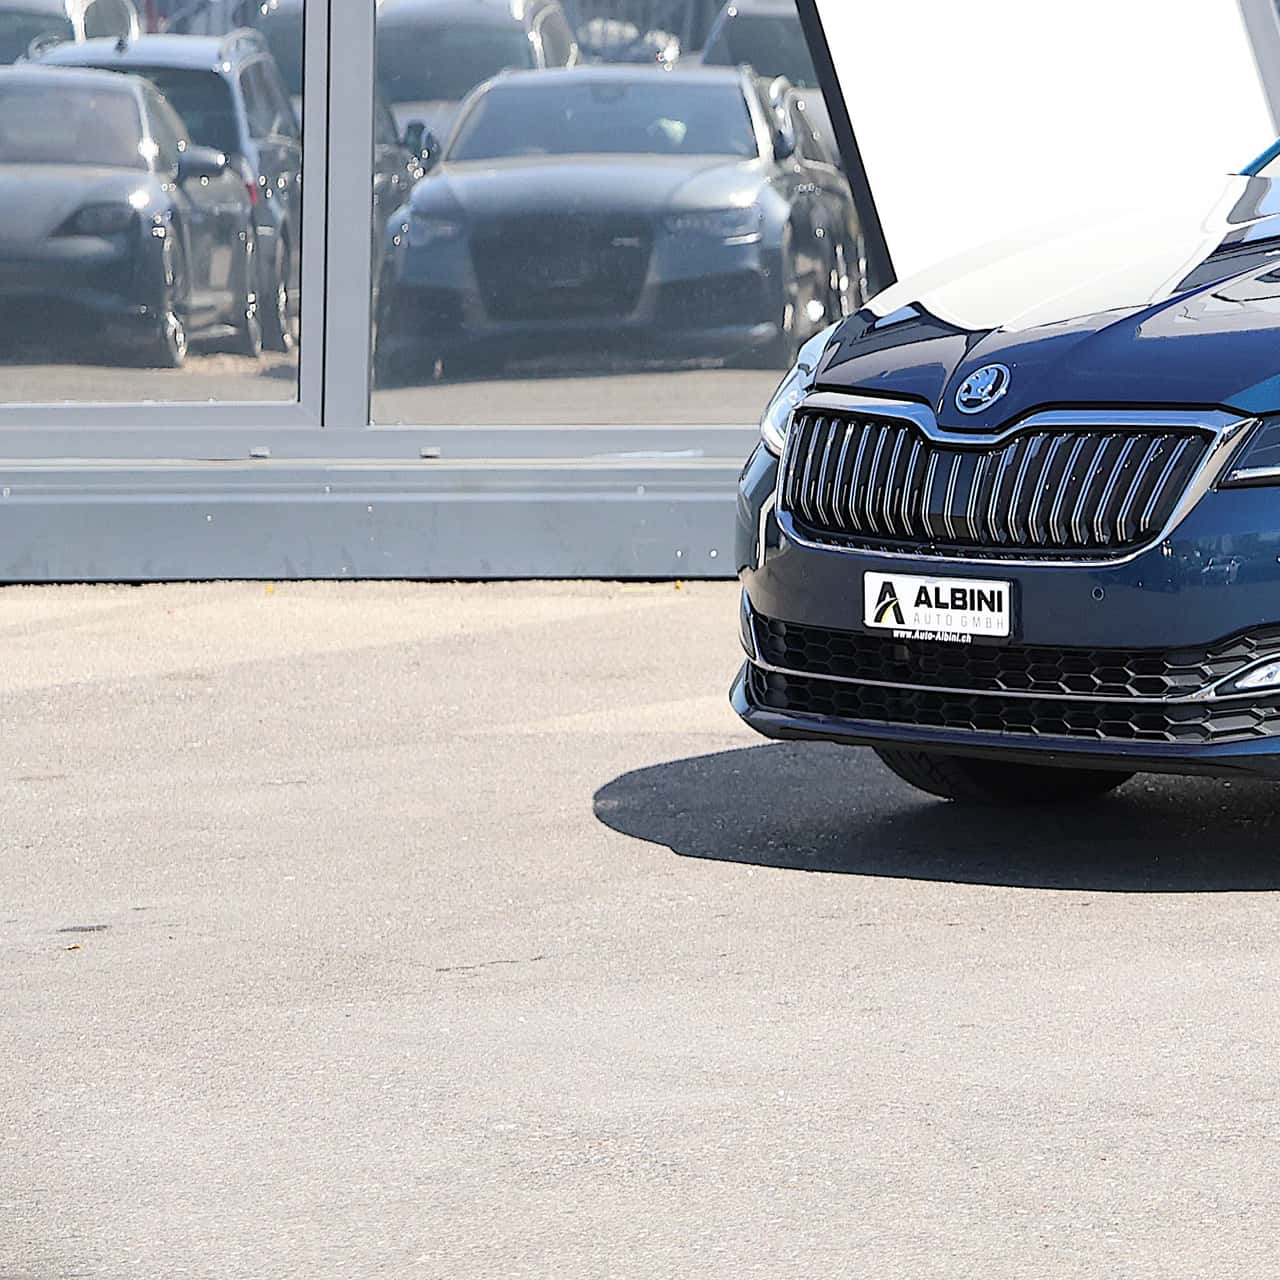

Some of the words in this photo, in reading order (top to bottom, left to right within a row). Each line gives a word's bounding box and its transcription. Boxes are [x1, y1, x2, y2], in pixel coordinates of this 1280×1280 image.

[914, 586, 1003, 613] ALBINI
[914, 613, 952, 626] AUTO
[961, 616, 1004, 629] GMBH
[893, 629, 972, 644] www.Auto-Albini.ch
